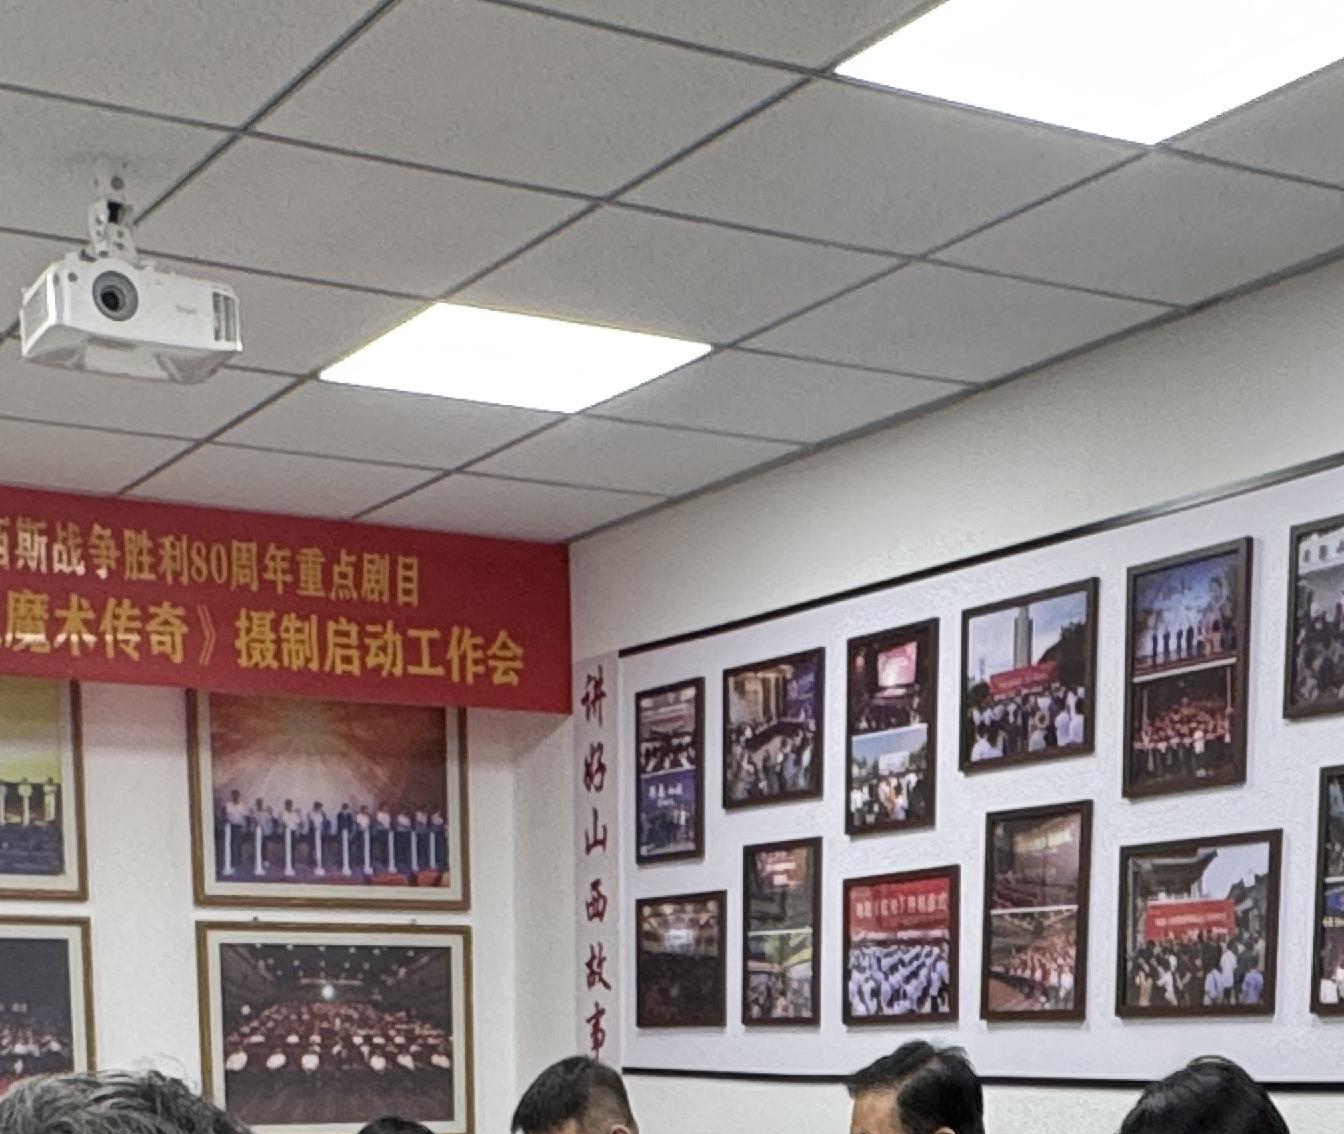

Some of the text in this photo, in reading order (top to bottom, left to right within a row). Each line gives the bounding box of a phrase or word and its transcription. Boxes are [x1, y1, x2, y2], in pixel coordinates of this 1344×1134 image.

[580, 665, 612, 1060] 讲好山西故事
